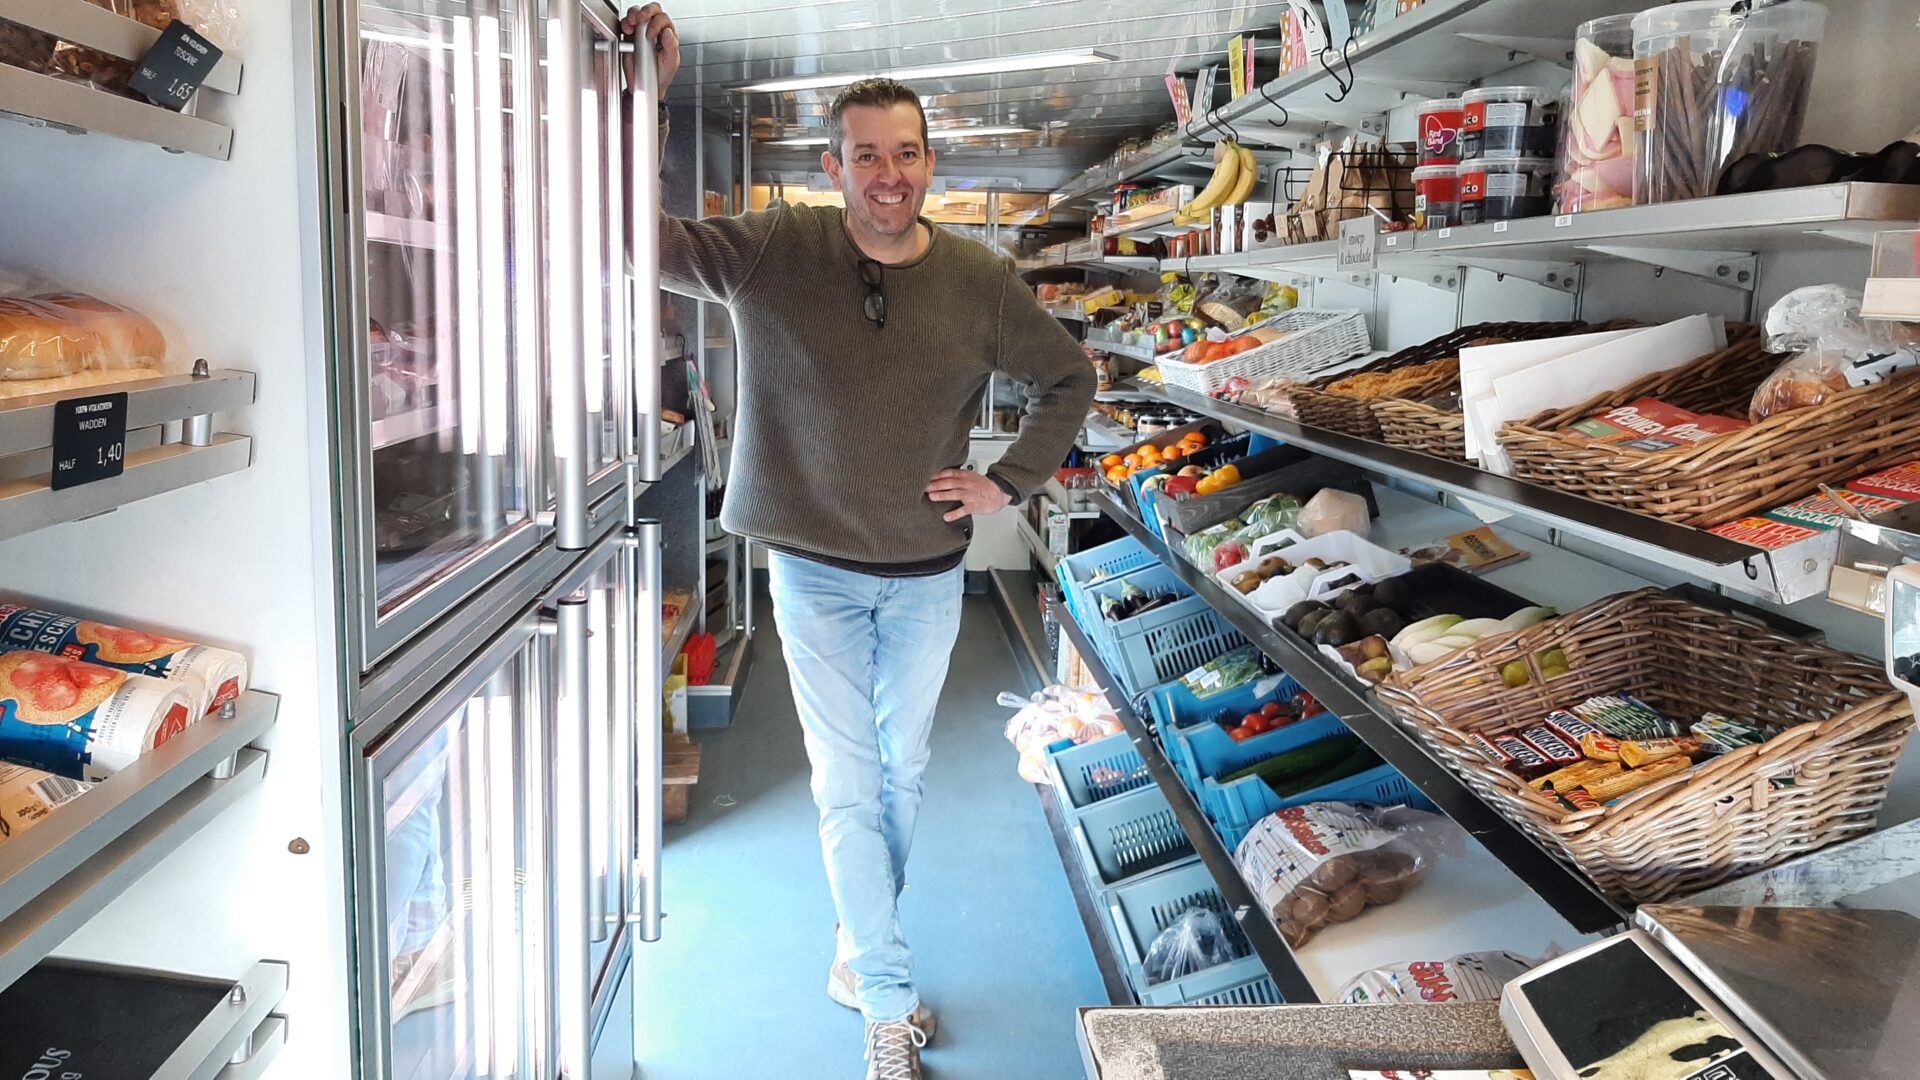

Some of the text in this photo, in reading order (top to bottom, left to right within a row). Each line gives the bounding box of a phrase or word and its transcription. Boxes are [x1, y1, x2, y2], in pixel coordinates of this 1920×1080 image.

[168, 79, 193, 99] 1,65
[1428, 129, 1442, 138] Red
[1427, 136, 1444, 146] Band
[79, 417, 107, 430] WADDEN
[59, 443, 121, 471] HALF 1,40
